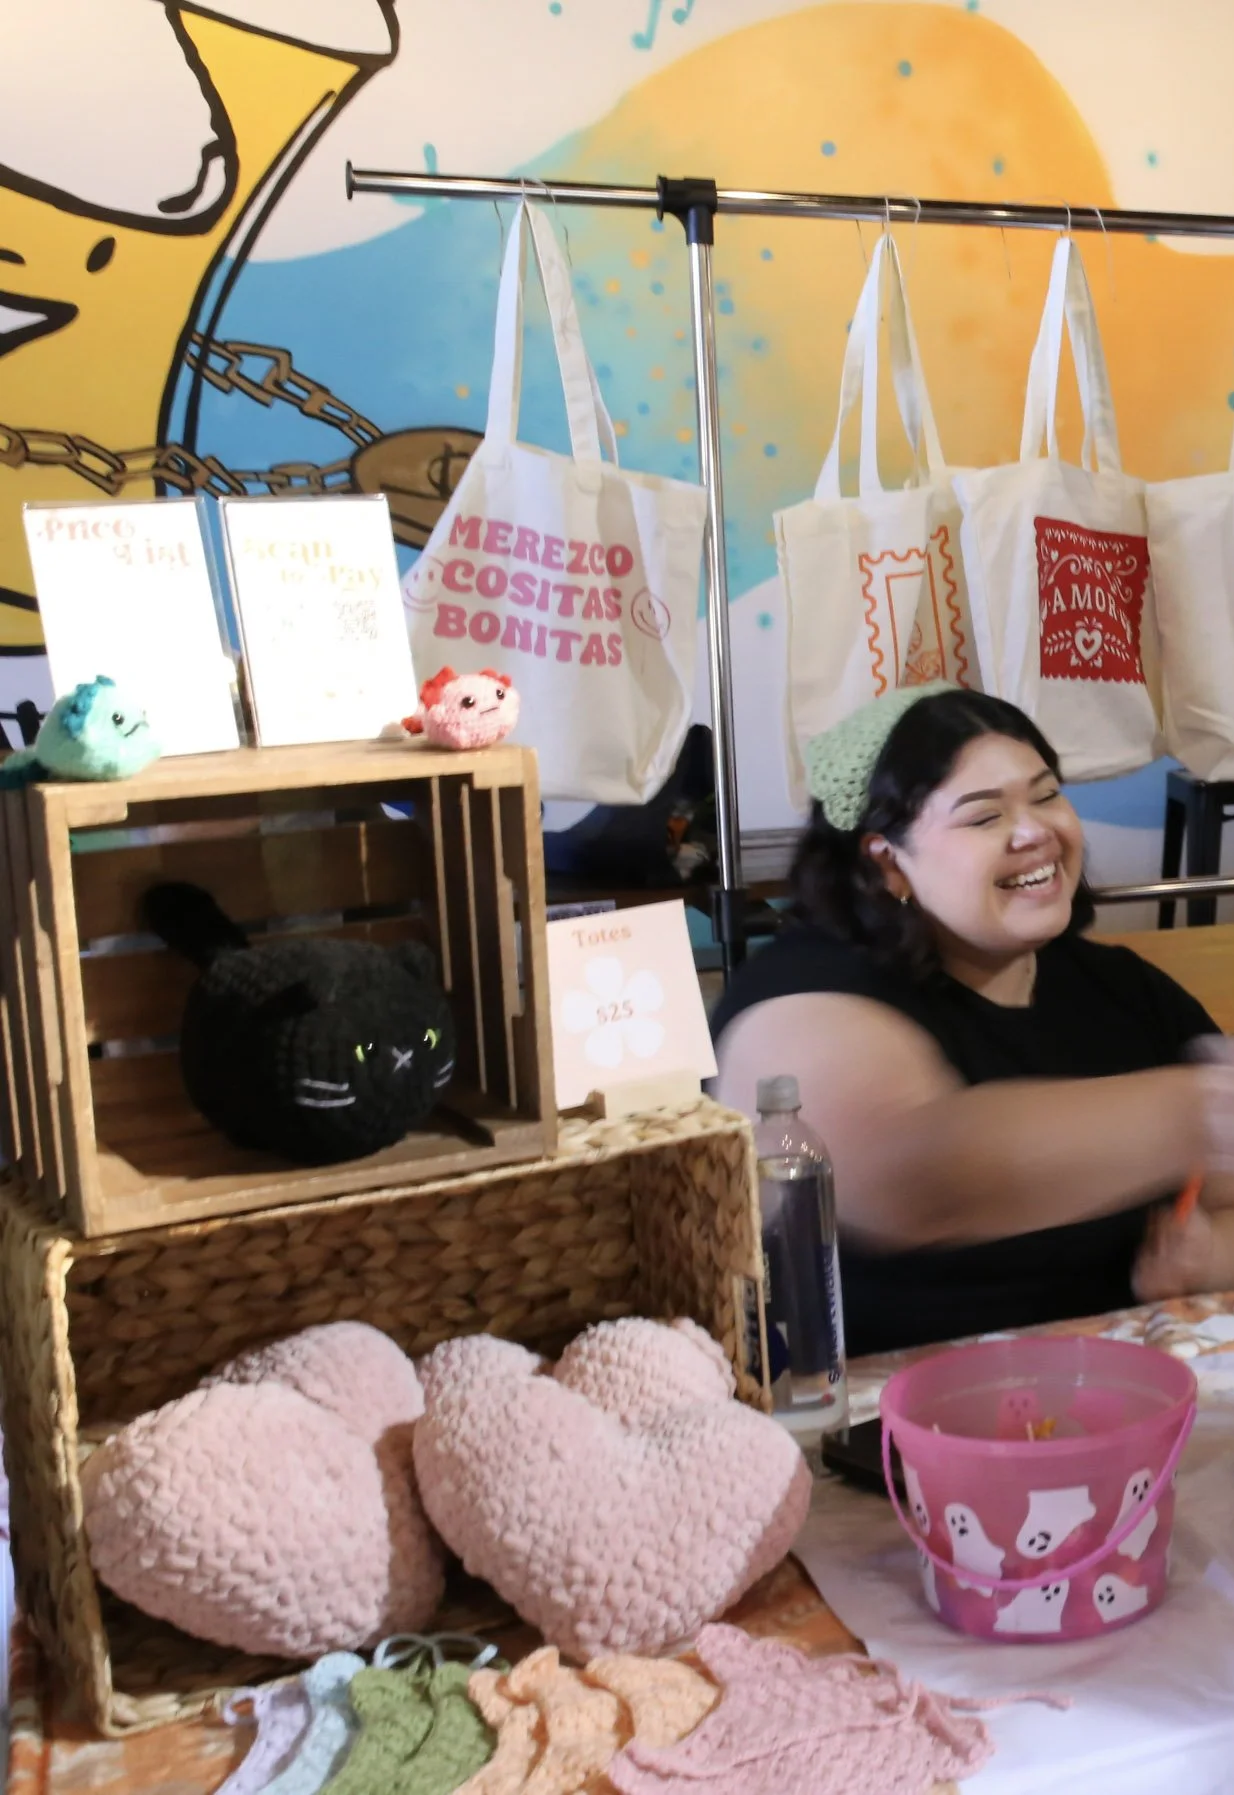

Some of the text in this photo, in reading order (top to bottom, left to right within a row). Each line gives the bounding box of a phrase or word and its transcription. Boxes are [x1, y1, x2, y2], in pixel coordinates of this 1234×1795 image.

[448, 513, 634, 577] MEREZCO
[441, 558, 622, 621] COSITAS
[1052, 583, 1117, 620] AMOR
[433, 603, 622, 666] BONITAS
[572, 925, 632, 948] Totes
